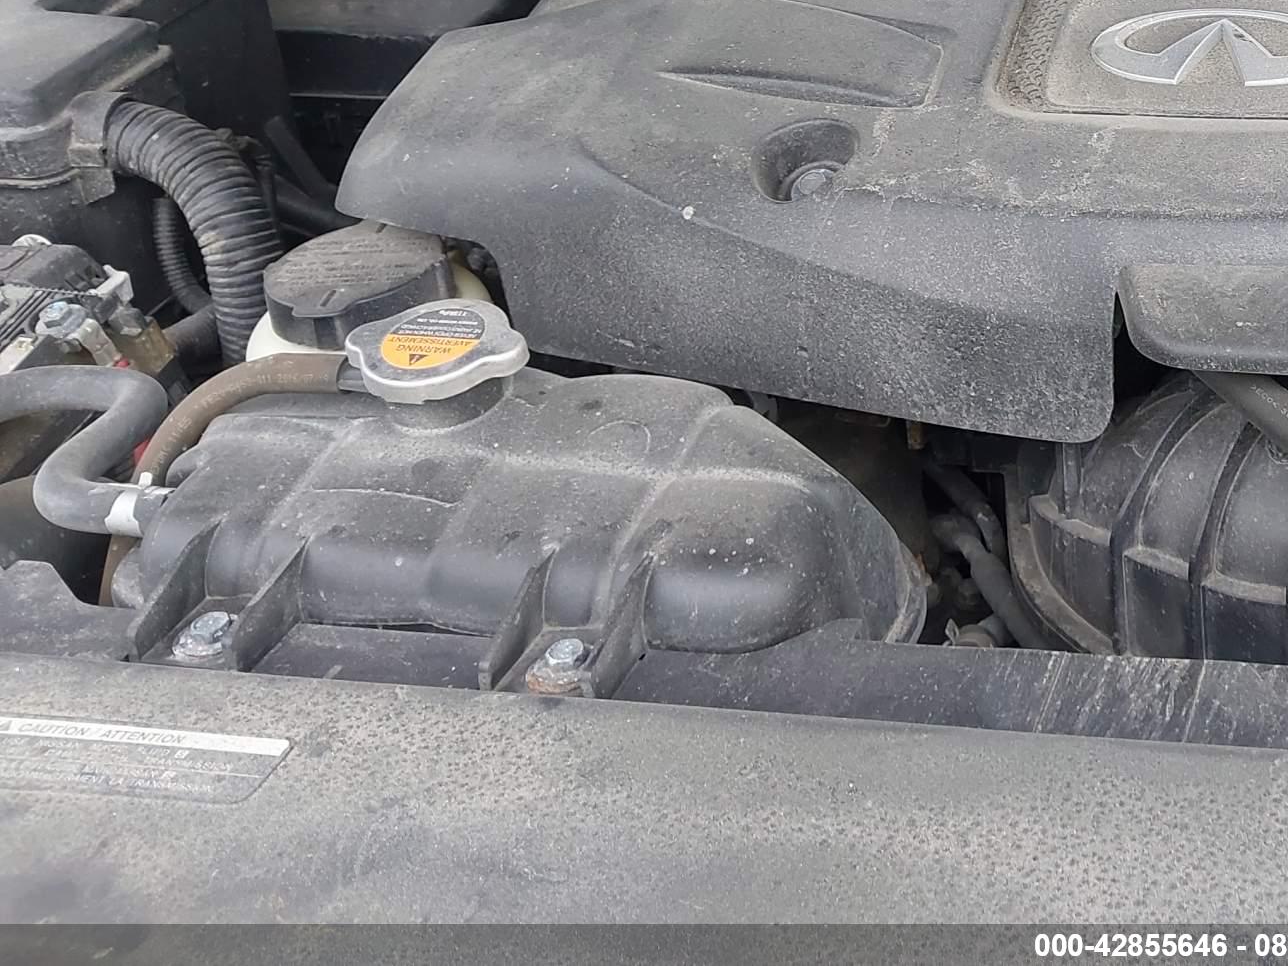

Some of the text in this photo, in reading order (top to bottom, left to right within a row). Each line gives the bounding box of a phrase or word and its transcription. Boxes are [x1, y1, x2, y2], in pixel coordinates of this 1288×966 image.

[388, 336, 473, 347] AVERTISSEMENT
[396, 344, 452, 354] WARNING
[18, 722, 187, 745] CAUTION ATTENTION
